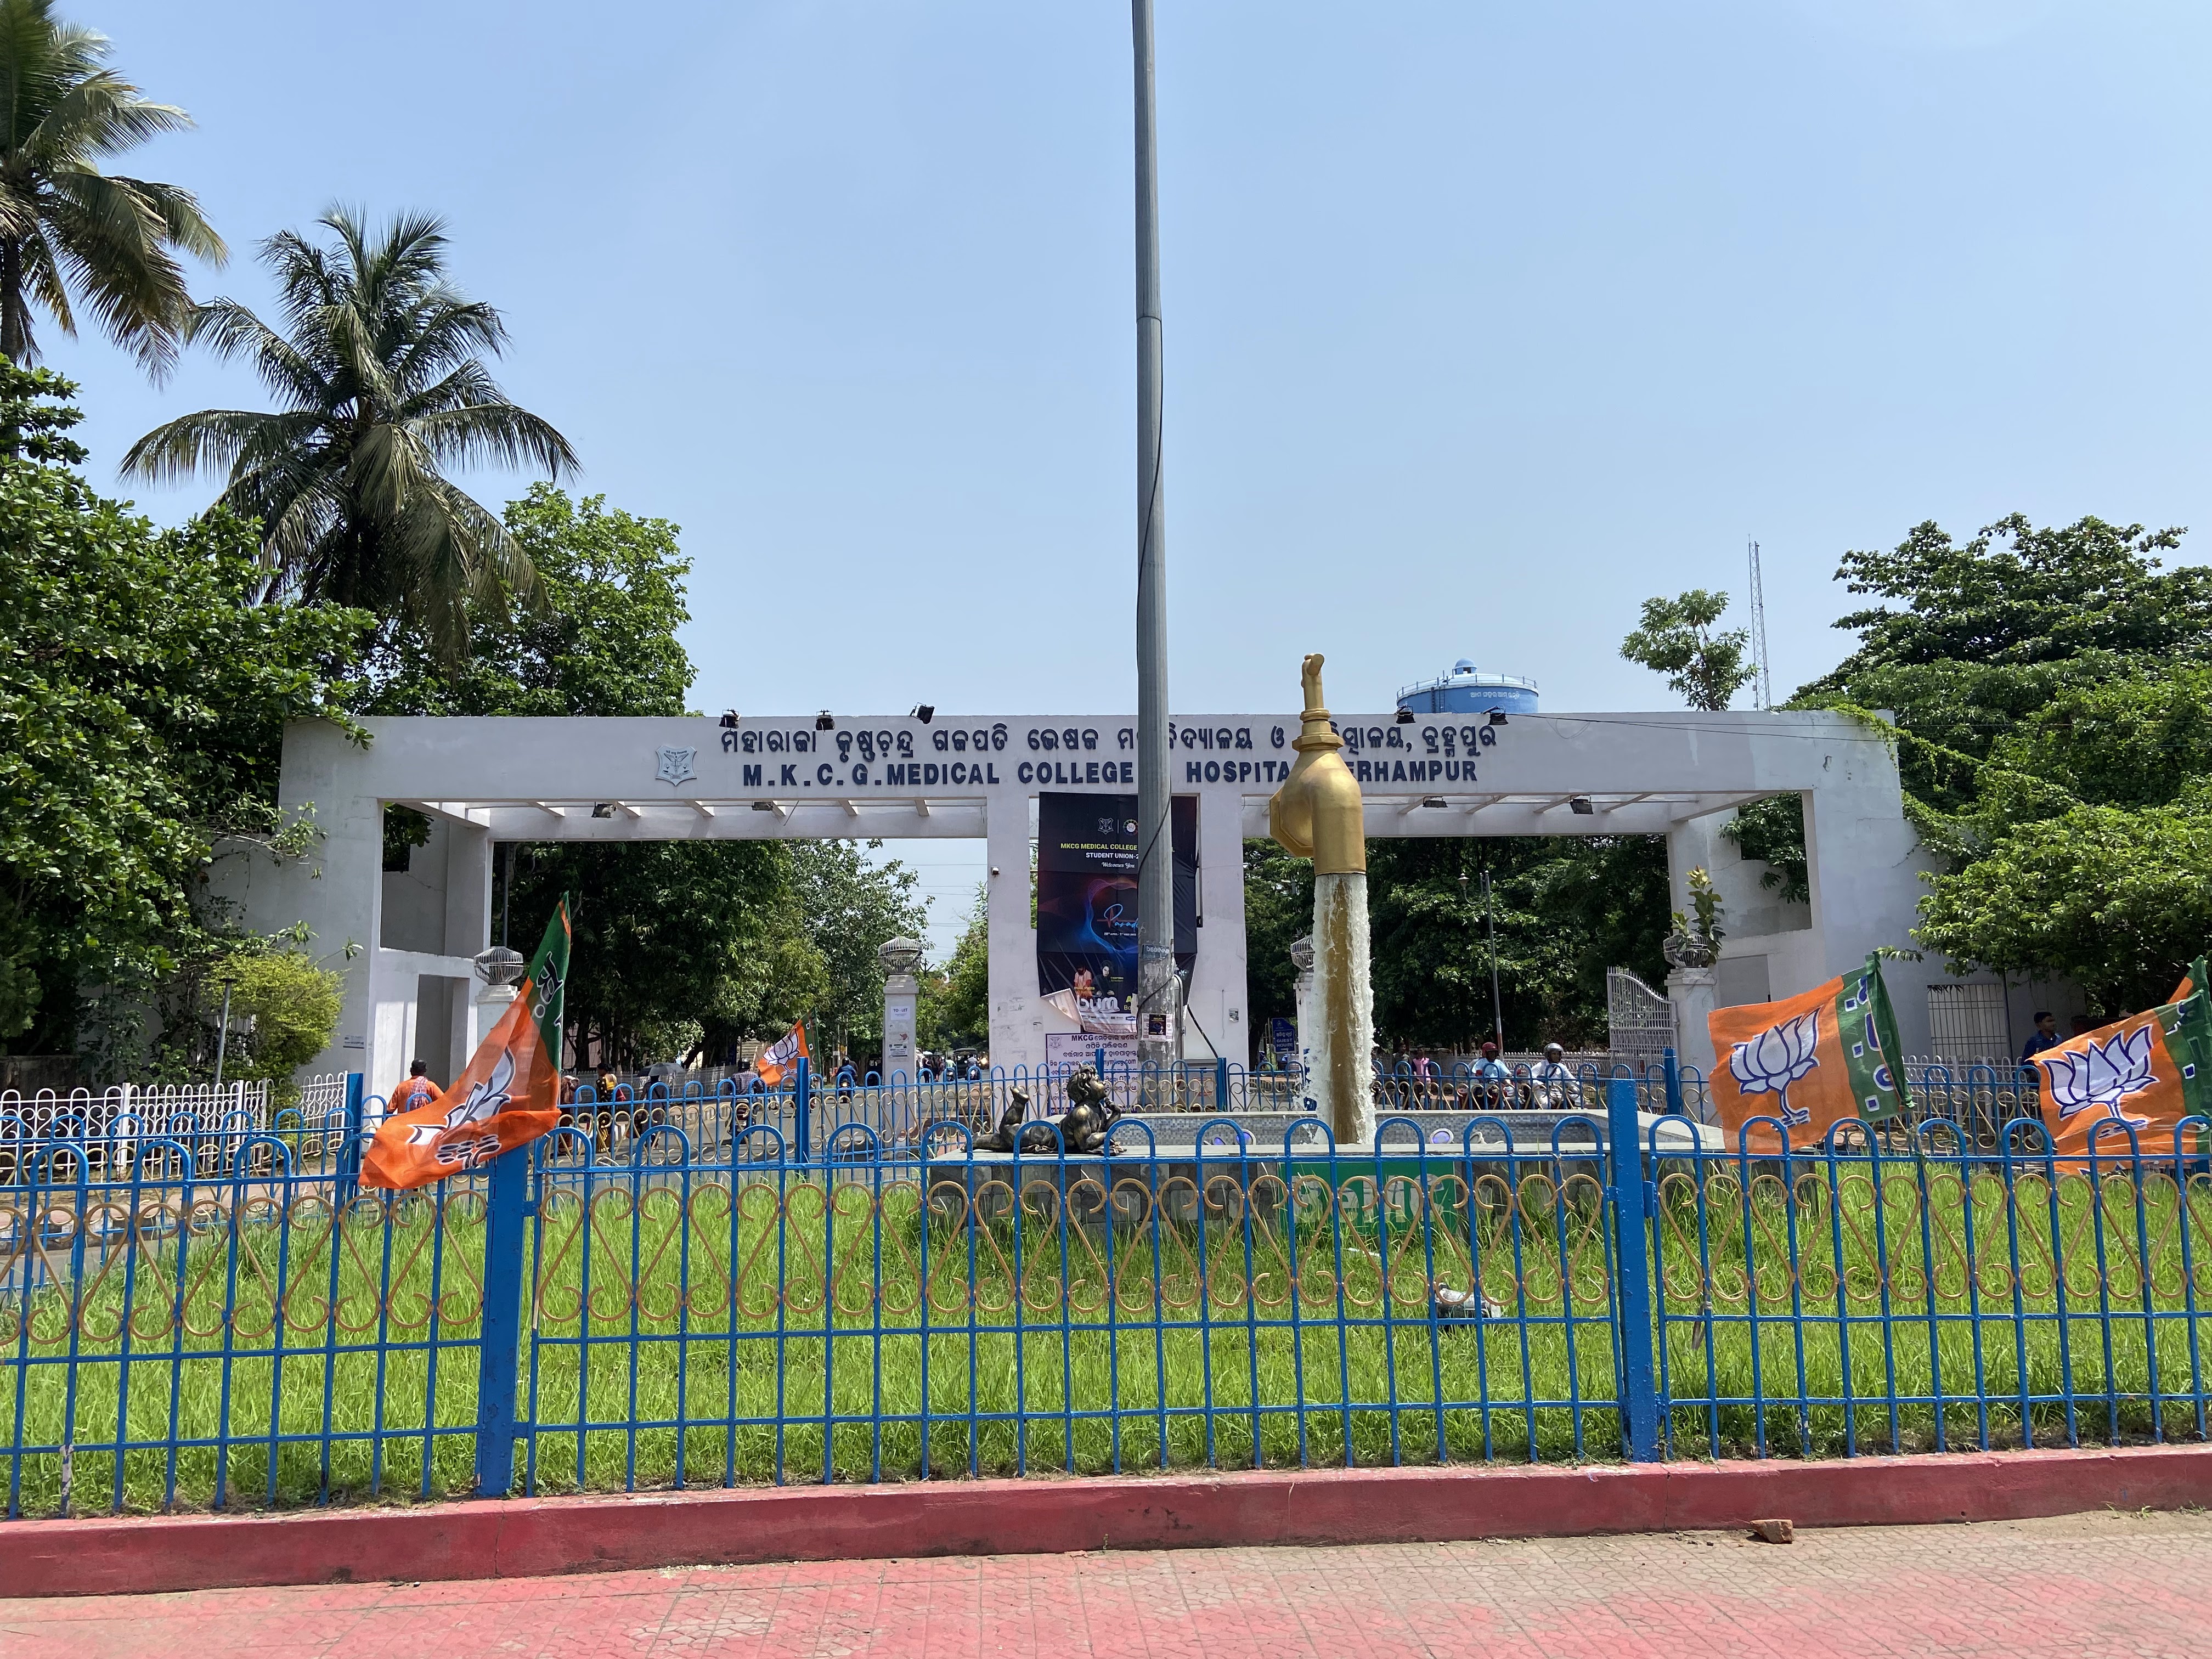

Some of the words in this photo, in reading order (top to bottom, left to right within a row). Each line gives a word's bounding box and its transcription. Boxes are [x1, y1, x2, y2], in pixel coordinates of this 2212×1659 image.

[721, 730, 816, 754] ମହାରାଜା
[933, 723, 1008, 751] ଗଜପତି
[1028, 729, 1099, 750] ଭେଷଜ
[1271, 725, 1285, 749] ଓ
[1018, 761, 1134, 784] COLLEGE
[1187, 760, 1290, 783] HOSPITA
